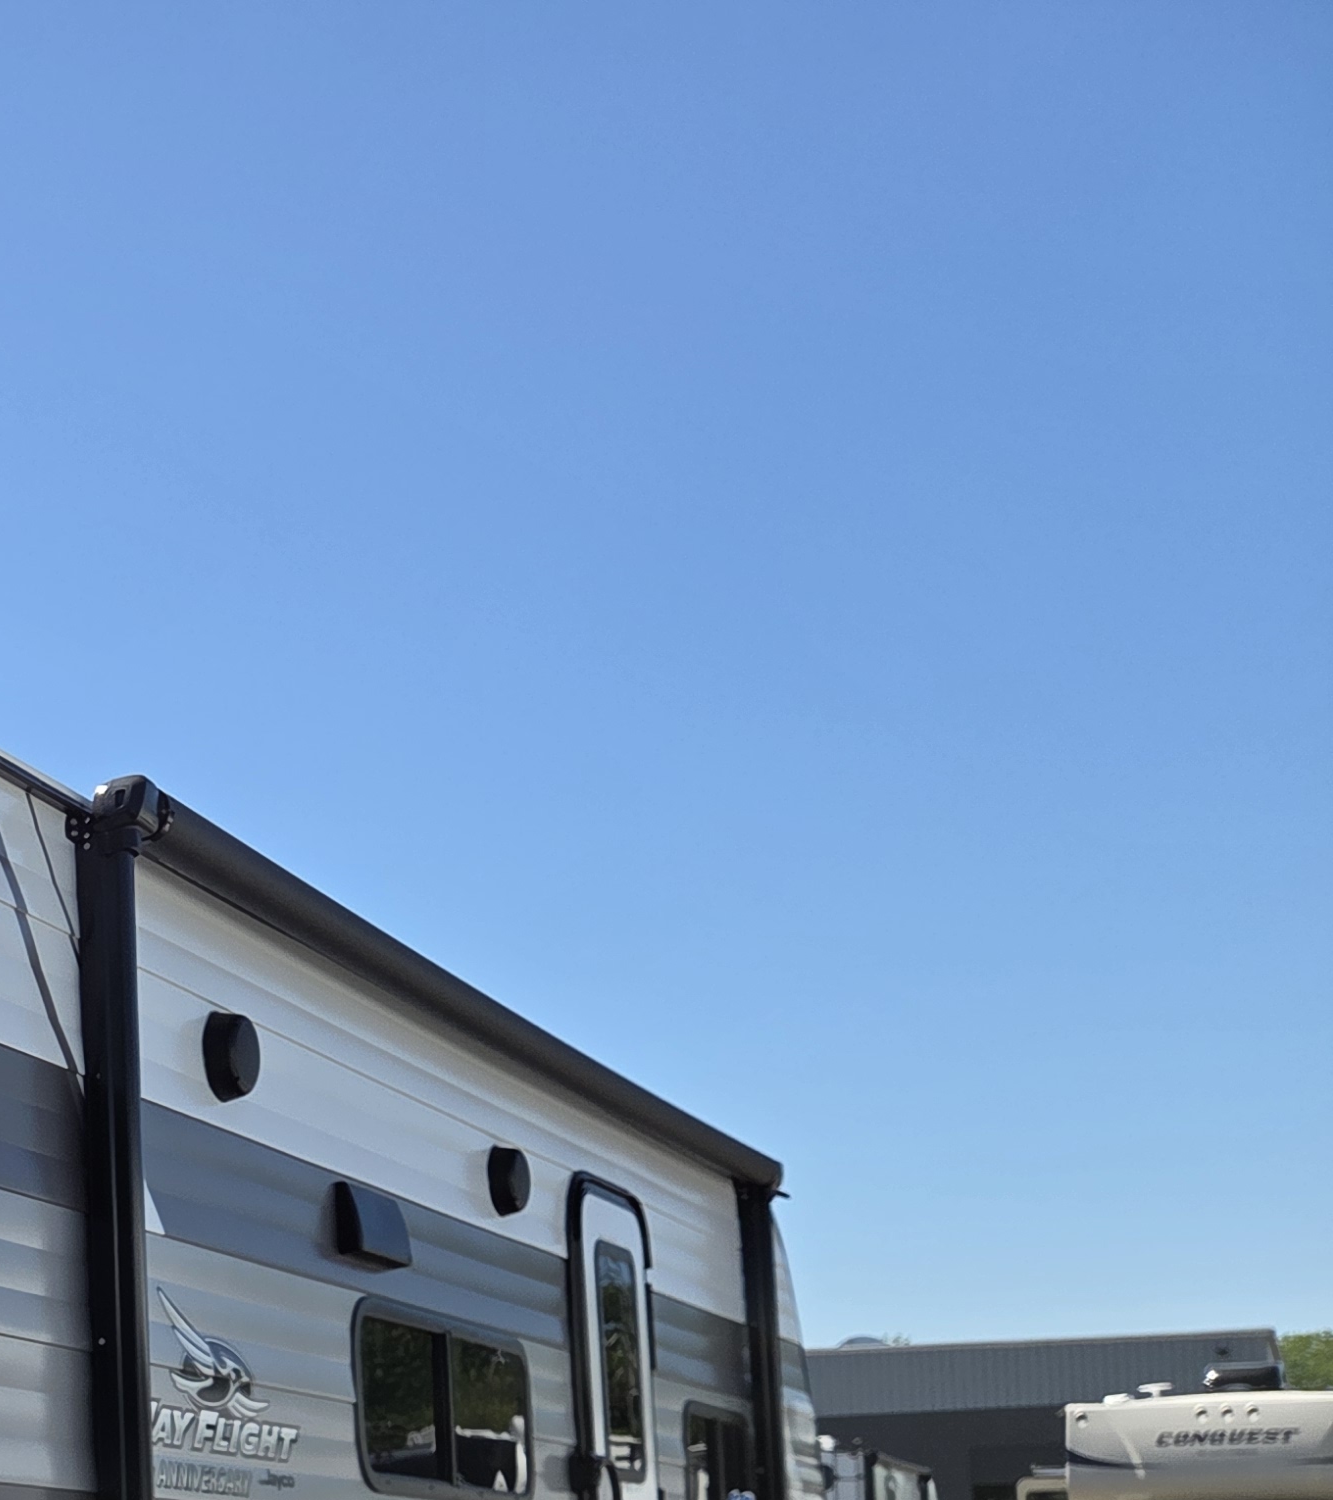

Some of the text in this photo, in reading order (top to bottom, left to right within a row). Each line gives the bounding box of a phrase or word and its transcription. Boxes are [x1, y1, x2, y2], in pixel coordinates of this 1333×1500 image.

[192, 1408, 300, 1461] FLIGHT
[1155, 1426, 1301, 1449] CONQUEST
[156, 1459, 252, 1497] ANNIVERSARY
